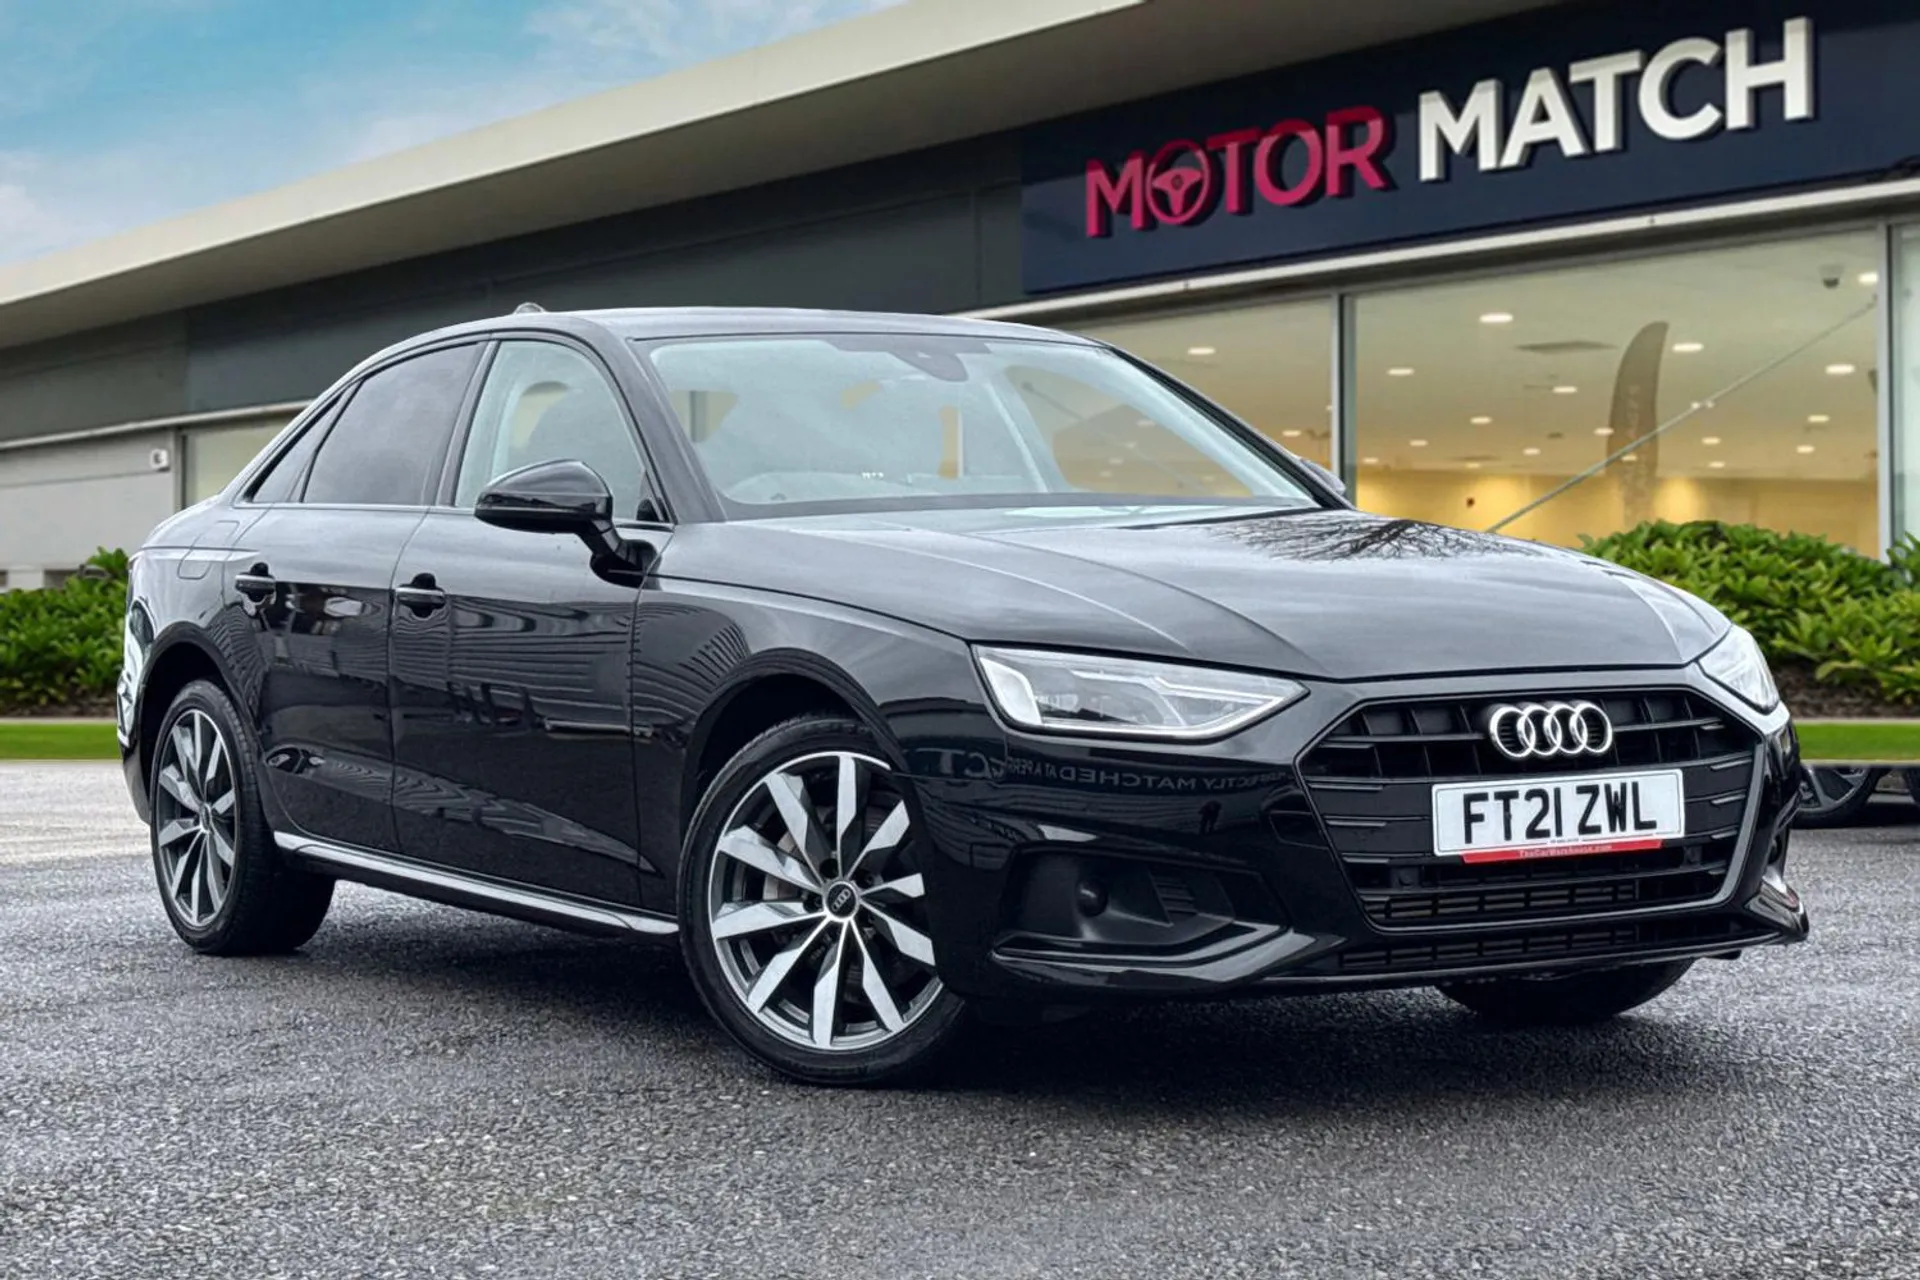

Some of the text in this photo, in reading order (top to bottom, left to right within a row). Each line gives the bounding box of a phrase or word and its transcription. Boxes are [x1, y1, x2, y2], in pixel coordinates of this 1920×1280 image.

[1085, 16, 1814, 237] MOTOR MATCH
[1463, 781, 1658, 845] FT21 ZWL
